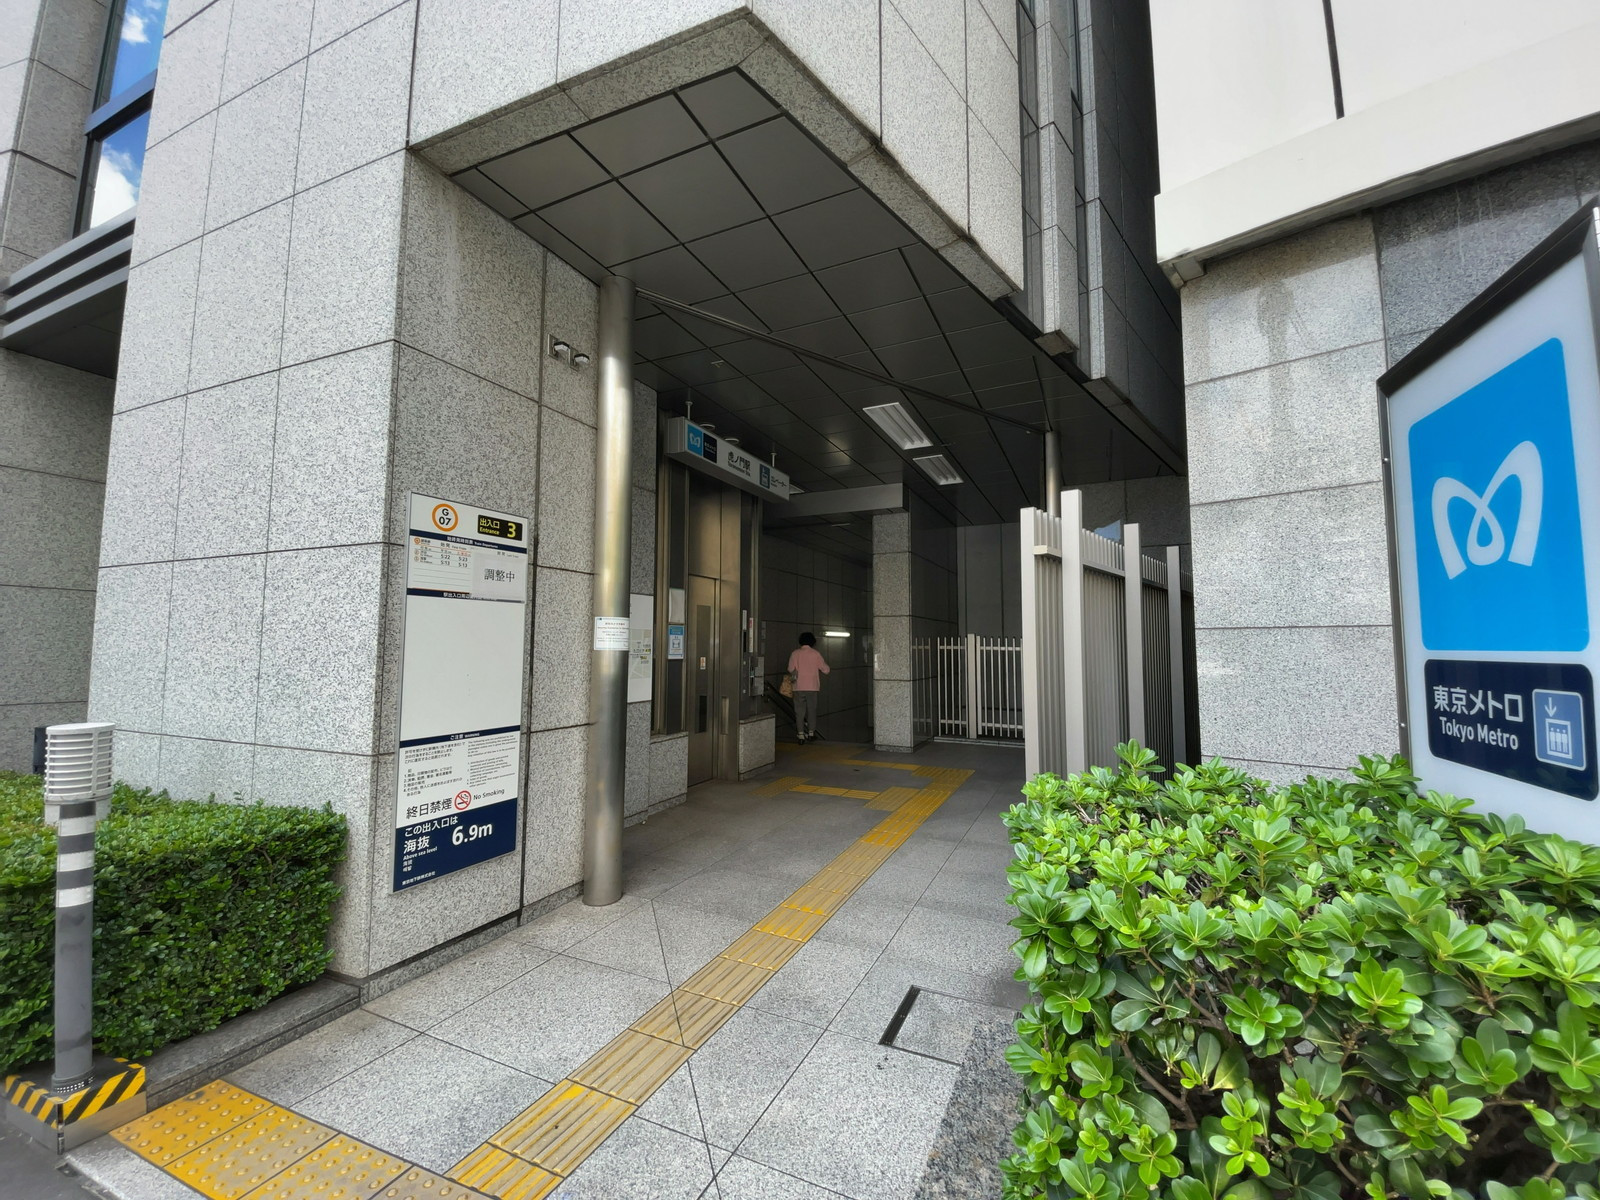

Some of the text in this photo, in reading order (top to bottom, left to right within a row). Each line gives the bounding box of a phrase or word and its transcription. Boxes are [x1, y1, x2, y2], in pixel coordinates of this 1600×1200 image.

[439, 517, 452, 526] 07
[442, 508, 450, 517] G
[479, 518, 516, 538] 出入口 3
[479, 526, 500, 535] Entrance
[484, 568, 516, 583] 調整中
[1433, 684, 1524, 723] 東京メトロ
[1439, 716, 1519, 751] Tokyo Metro
[473, 788, 505, 801] No Smoking
[407, 798, 452, 820] 終日禁煙
[405, 816, 458, 837] この出入口は
[452, 823, 493, 846] 6.9m
[403, 853, 418, 861] Above
[426, 845, 438, 855] level
[404, 836, 430, 855] 海抜
